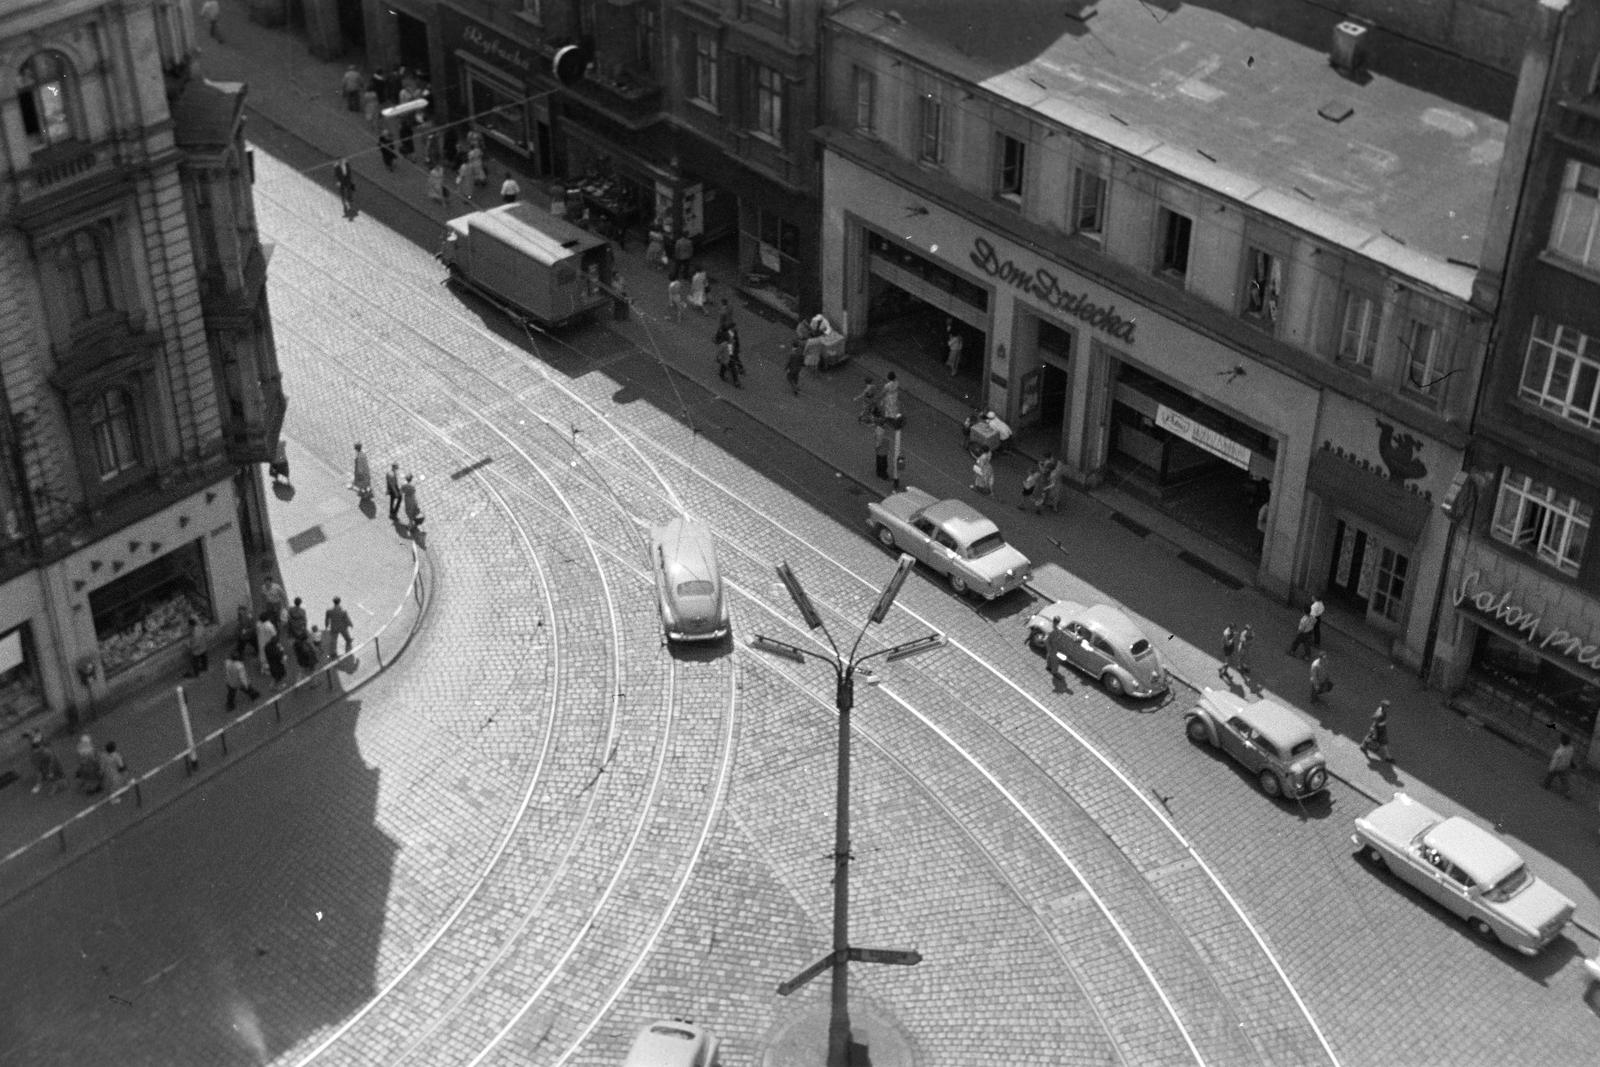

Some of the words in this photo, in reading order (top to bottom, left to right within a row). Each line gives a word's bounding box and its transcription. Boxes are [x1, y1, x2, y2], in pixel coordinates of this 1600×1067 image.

[969, 237, 1034, 293] Dom
[1031, 268, 1136, 344] Dziecka
[1452, 571, 1541, 642] Salon
